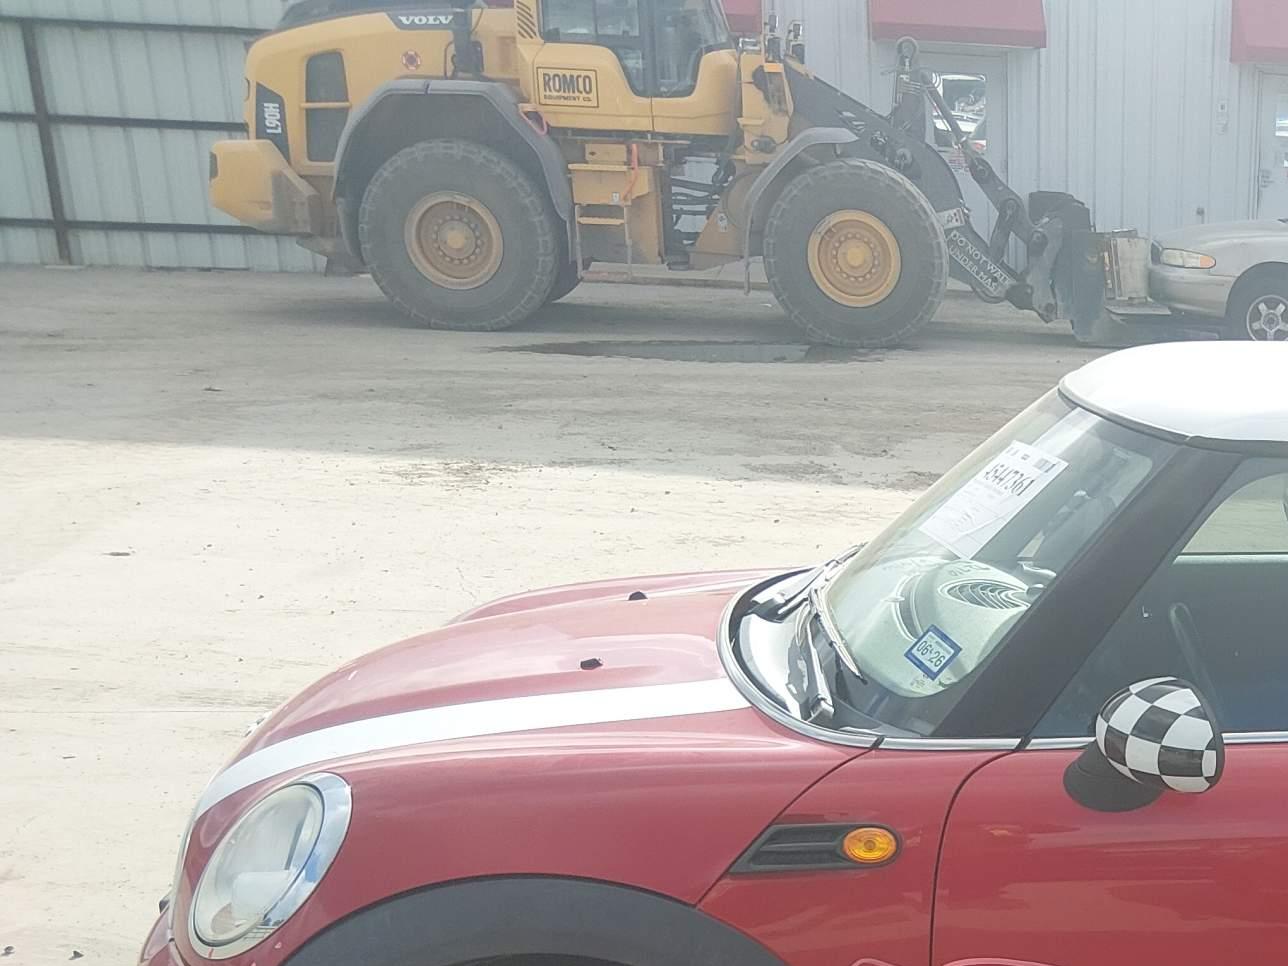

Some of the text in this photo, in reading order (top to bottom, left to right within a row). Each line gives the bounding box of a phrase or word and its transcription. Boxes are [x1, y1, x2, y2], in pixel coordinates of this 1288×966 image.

[398, 15, 454, 25] VOLV
[543, 73, 593, 95] ROMCO
[263, 102, 282, 134] L90H
[950, 229, 966, 247] DO
[966, 243, 988, 265] NOT
[916, 640, 932, 656] 06
[928, 650, 946, 668] 26
